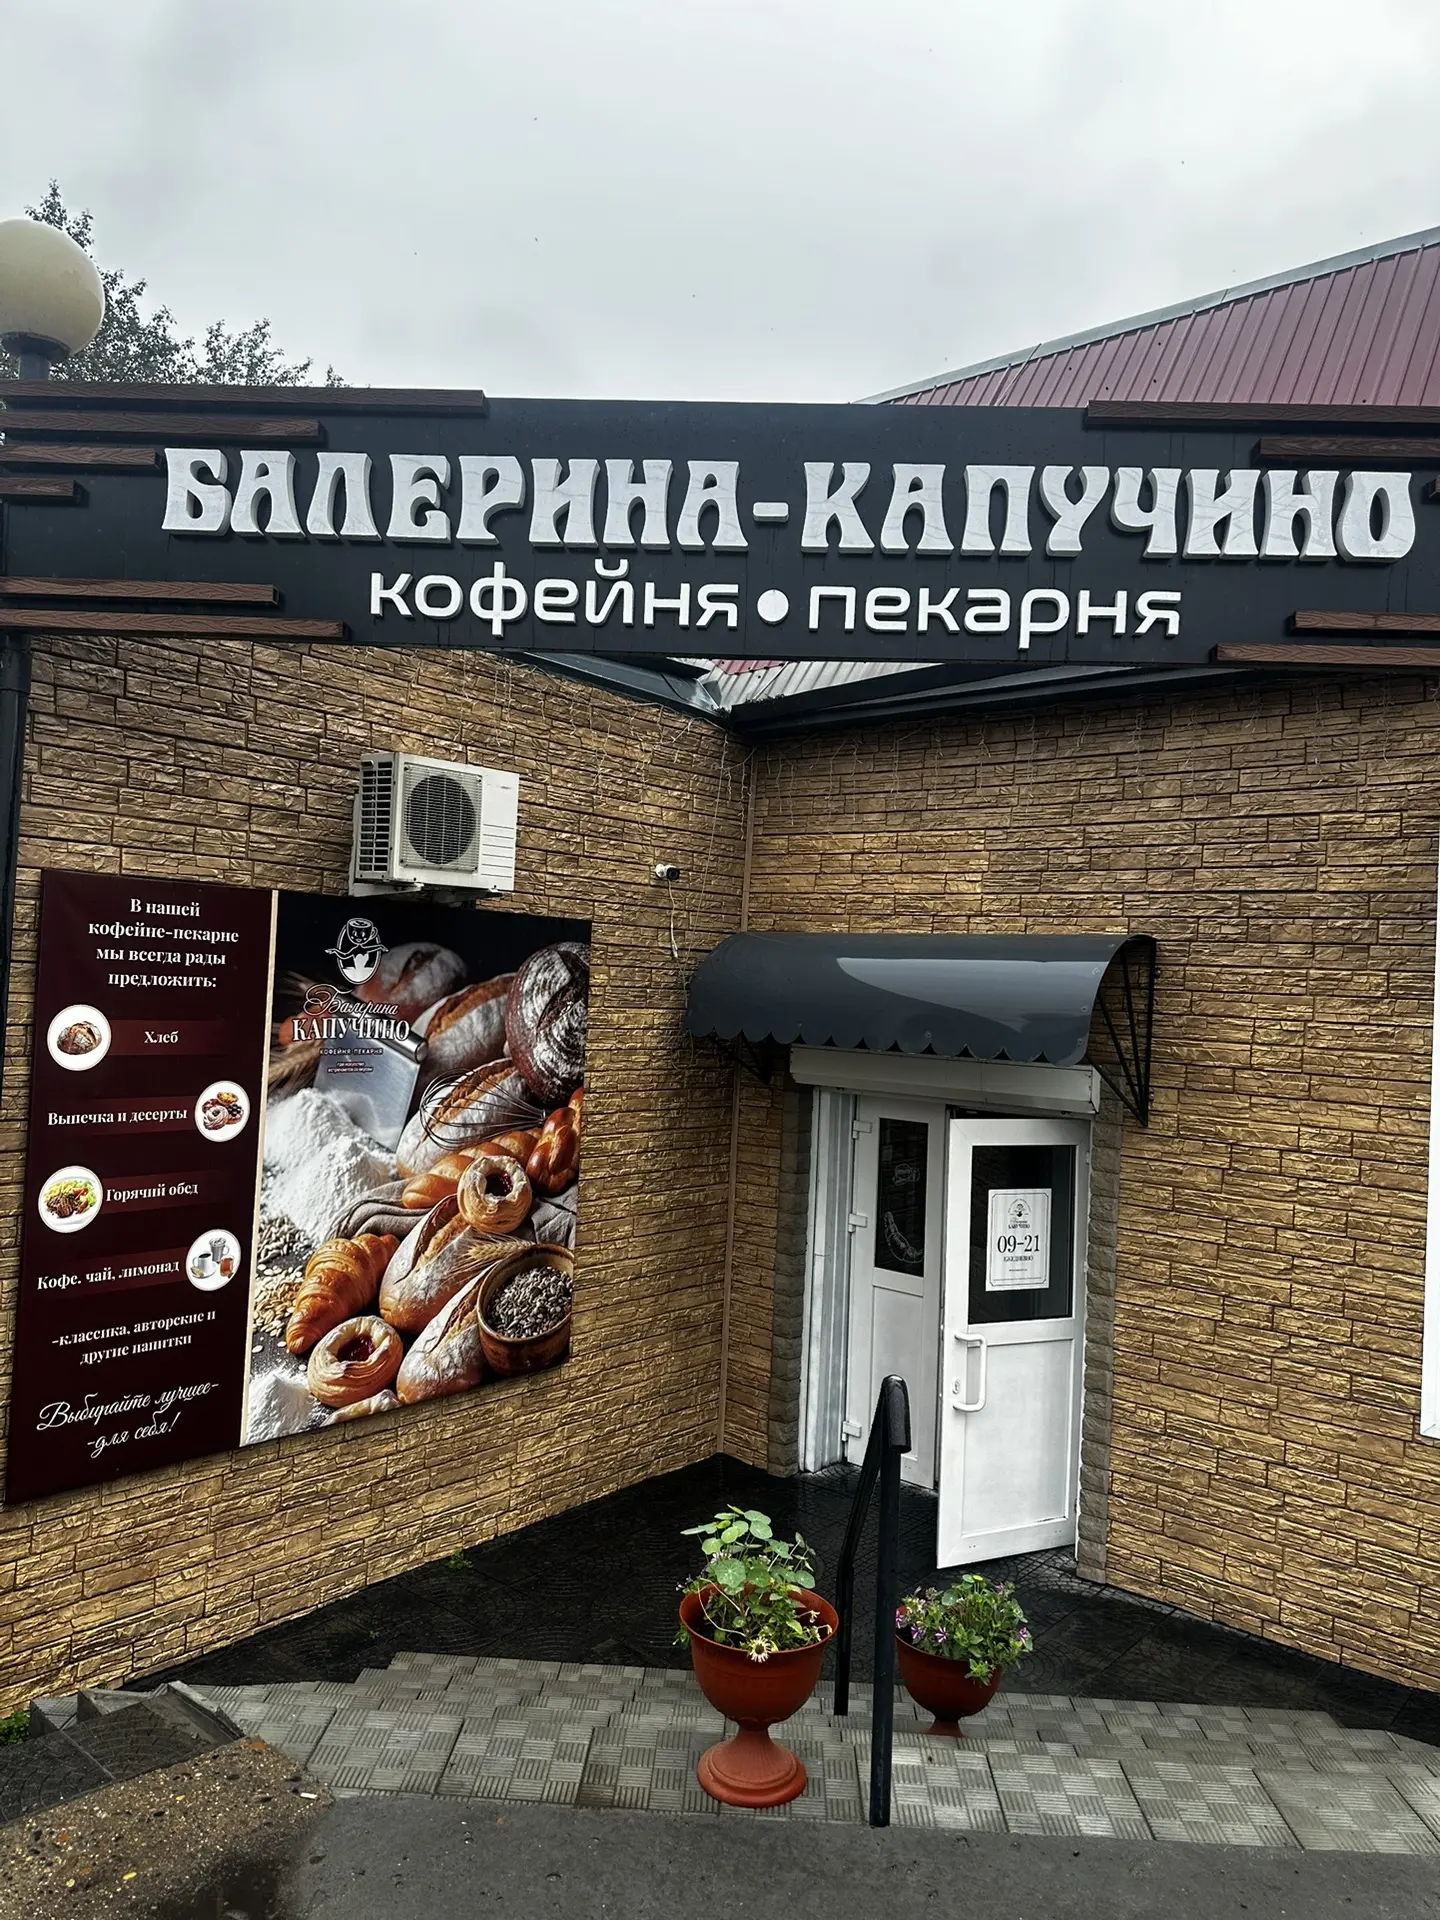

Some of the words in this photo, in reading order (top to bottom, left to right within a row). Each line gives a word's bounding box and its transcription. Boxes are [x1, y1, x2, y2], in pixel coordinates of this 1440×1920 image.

[161, 447, 1417, 564] БАЛЕРИНА-КАПУЧИНО
[370, 558, 739, 637] кофейня
[808, 585, 1182, 651] пекарня
[130, 898, 142, 913] В
[146, 901, 201, 917] нашей
[88, 921, 240, 944] кофейне-пекарне
[96, 948, 125, 961] мы
[129, 950, 181, 964] всегда
[185, 953, 226, 966] рады
[108, 972, 217, 988] предложить:
[303, 983, 400, 1023] Балерина
[144, 1030, 179, 1044] Хлеб
[292, 1018, 410, 1041] КАПУЧИНО
[47, 1111, 115, 1126] Выпечка
[117, 1112, 127, 1122] и
[129, 1108, 188, 1123] десерты
[106, 1185, 166, 1202] Горячий
[169, 1182, 198, 1197] обед
[997, 1234, 1040, 1253] 09-21
[85, 1267, 116, 1282] чай,
[118, 1261, 180, 1279] лимонад
[133, 1312, 205, 1333] авторские
[207, 1310, 216, 1321] и
[79, 1346, 130, 1366] другие
[132, 1334, 192, 1354] напитки
[36, 1392, 152, 1431] Выбирайте
[134, 1411, 182, 1439] себя!
